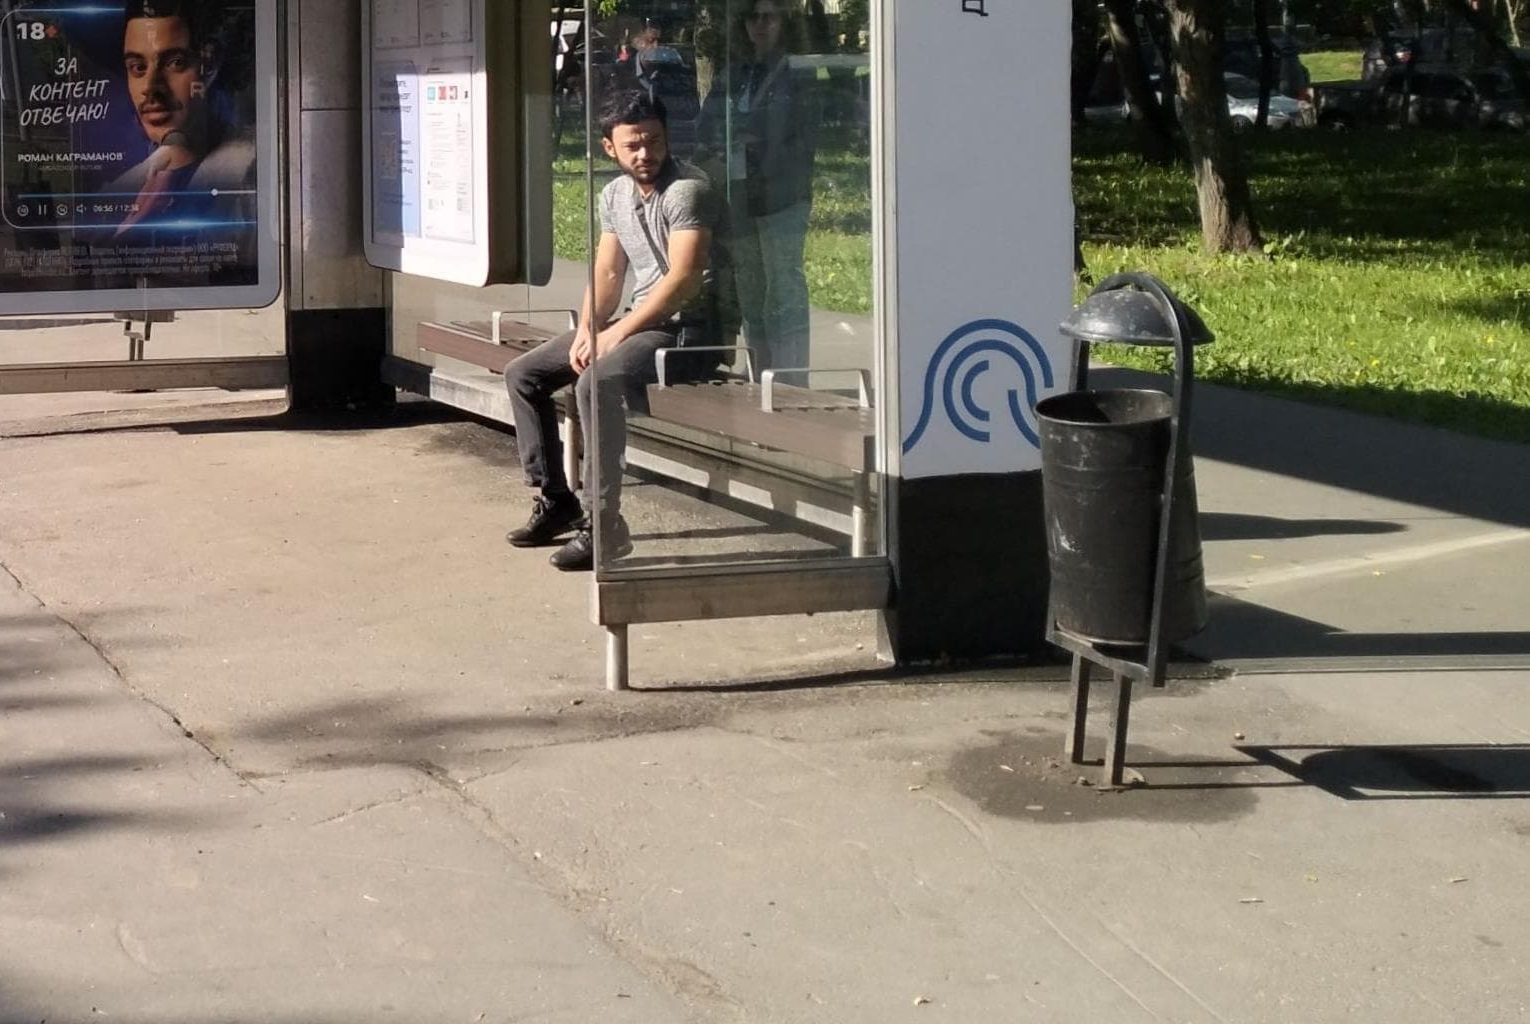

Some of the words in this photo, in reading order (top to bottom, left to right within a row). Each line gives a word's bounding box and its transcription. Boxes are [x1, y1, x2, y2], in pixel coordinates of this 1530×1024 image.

[16, 22, 57, 40] 18+
[54, 57, 78, 75] ЗА
[29, 79, 110, 102] КОНТЕНТ
[19, 101, 110, 127] ОТВЕЧАЮ!
[17, 152, 54, 162] РОМАН
[56, 151, 123, 162] КАГРАМАНОВ
